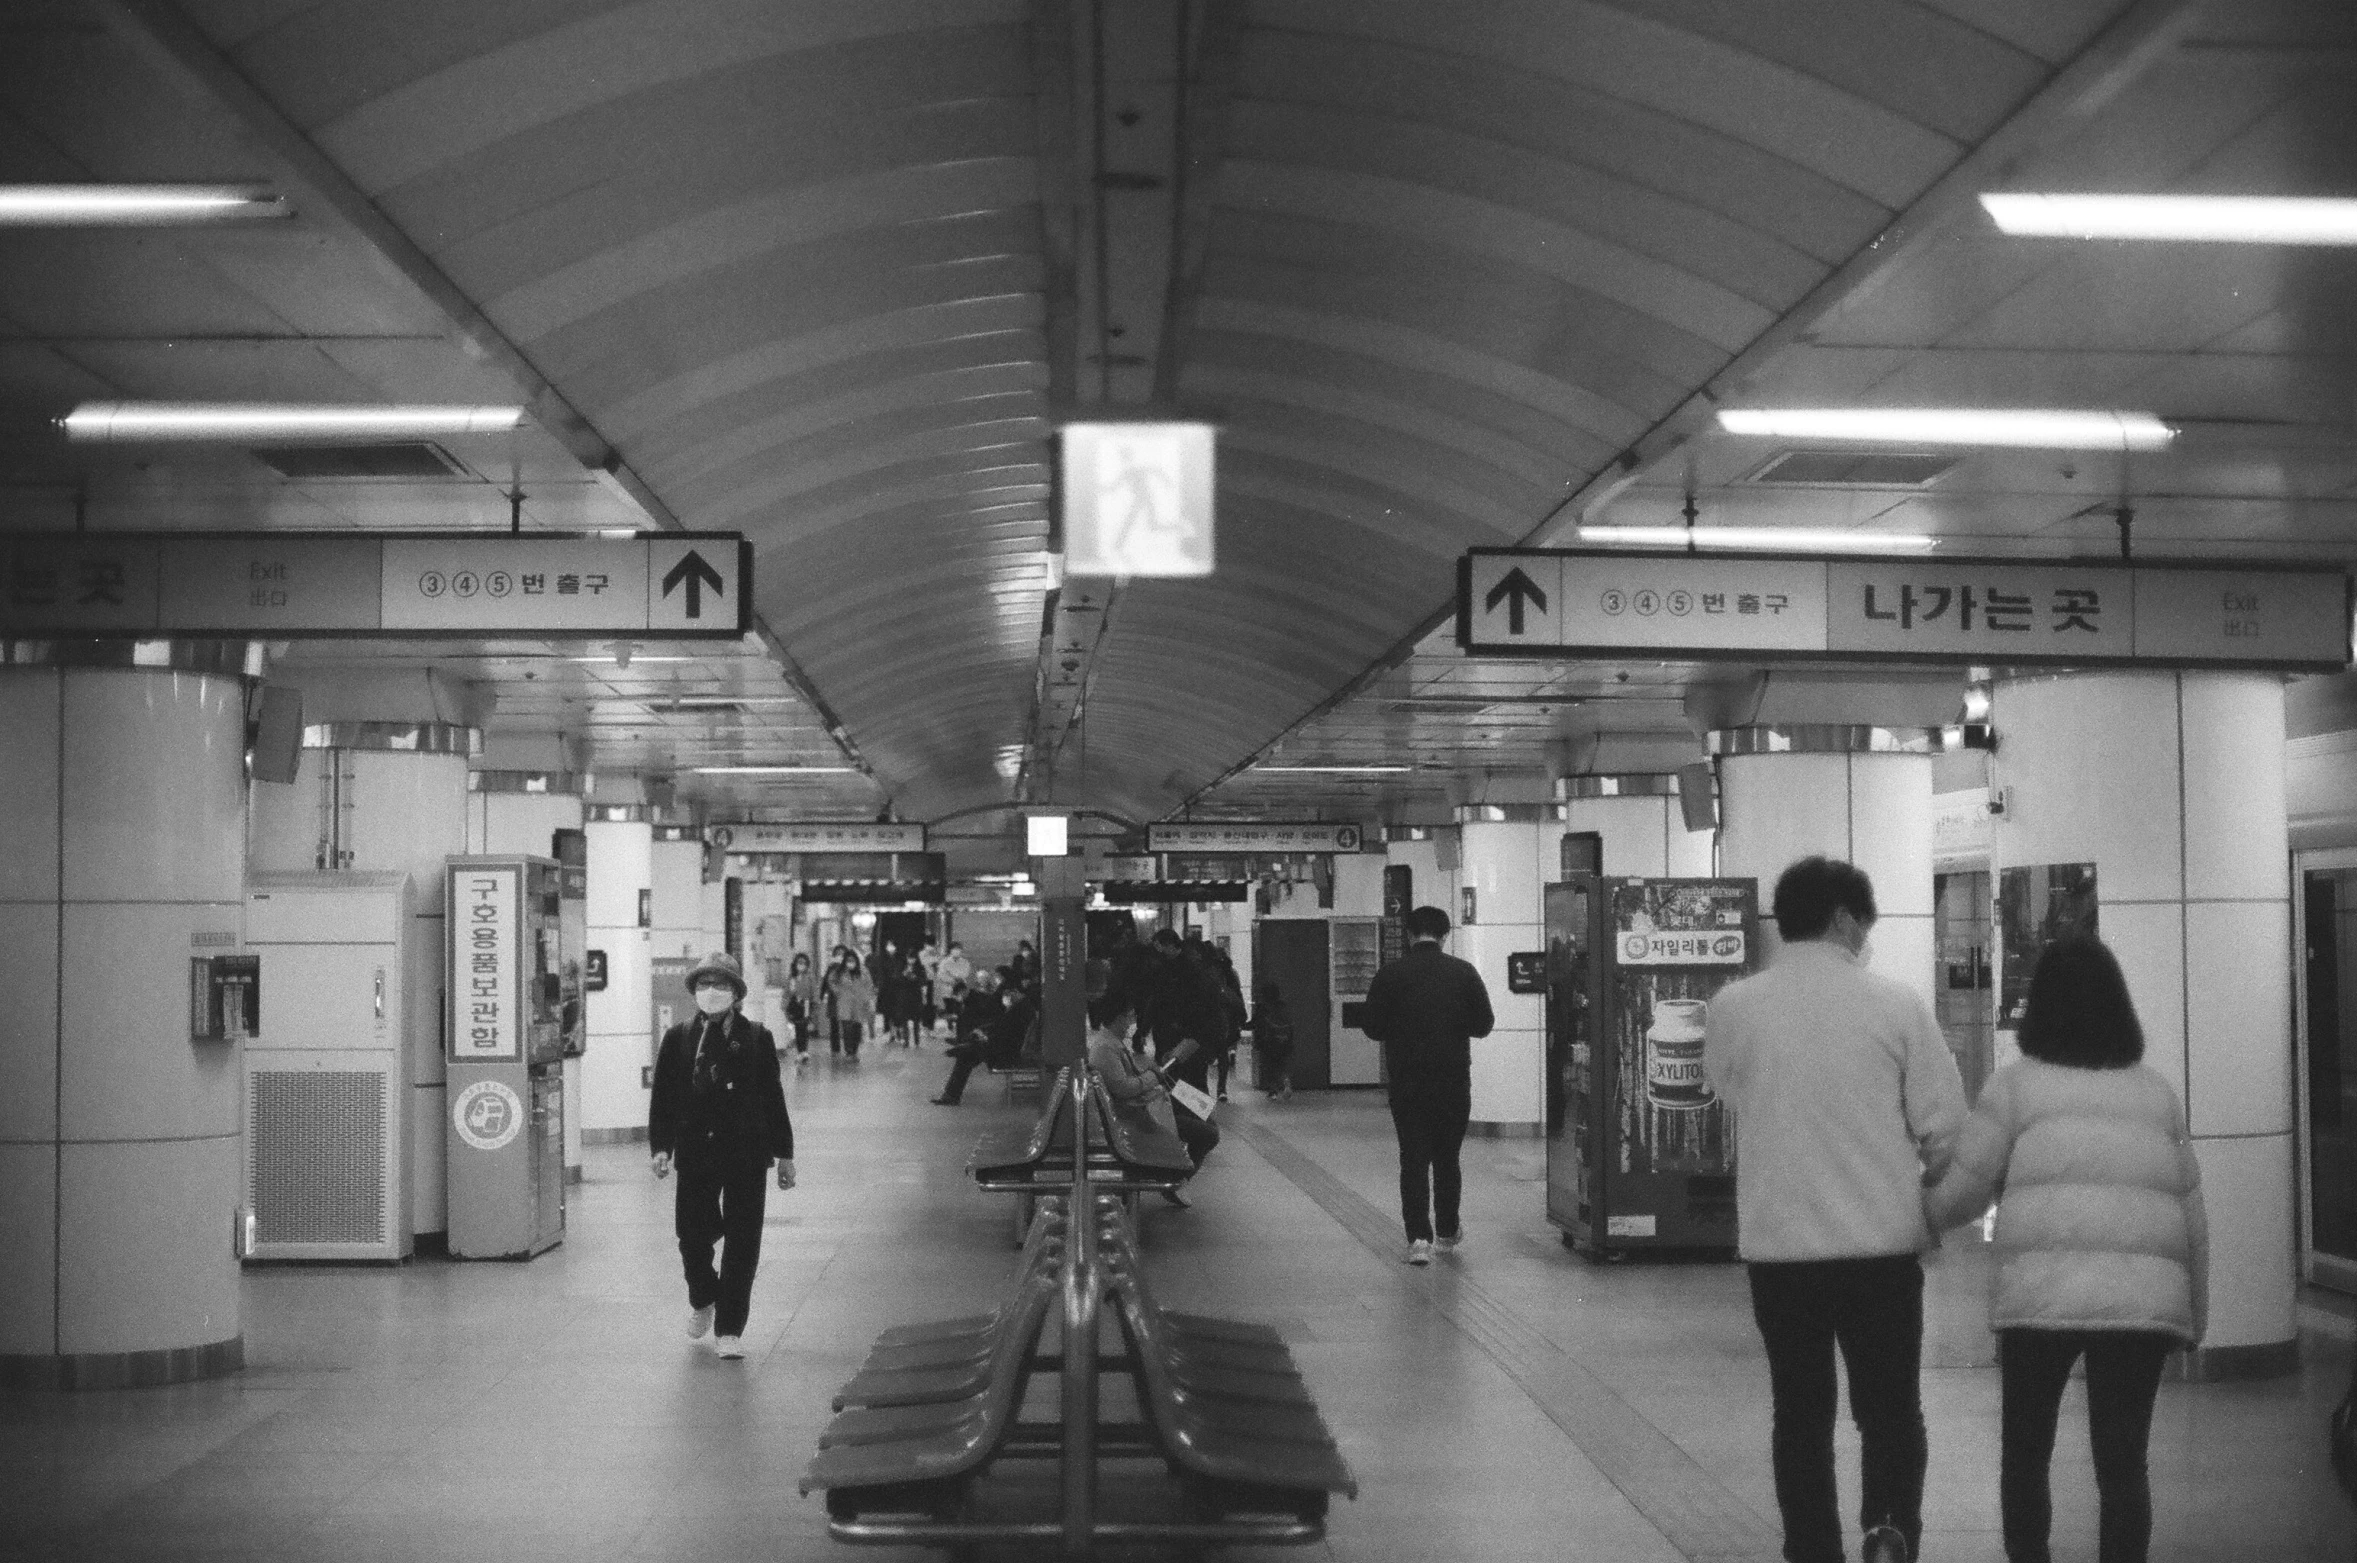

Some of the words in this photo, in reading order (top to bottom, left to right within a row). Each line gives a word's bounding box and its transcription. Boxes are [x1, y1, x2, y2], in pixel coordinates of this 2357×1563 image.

[250, 560, 287, 581] Exit
[557, 573, 609, 595] 출구
[1738, 593, 1789, 614] 출구
[1865, 584, 2033, 631] 나가는
[2051, 588, 2100, 633] 곳
[2223, 591, 2259, 611] Exit
[2223, 619, 2259, 637] 出口
[1651, 939, 1710, 956] 자일리톨
[471, 878, 499, 1048] 구호용품보관함
